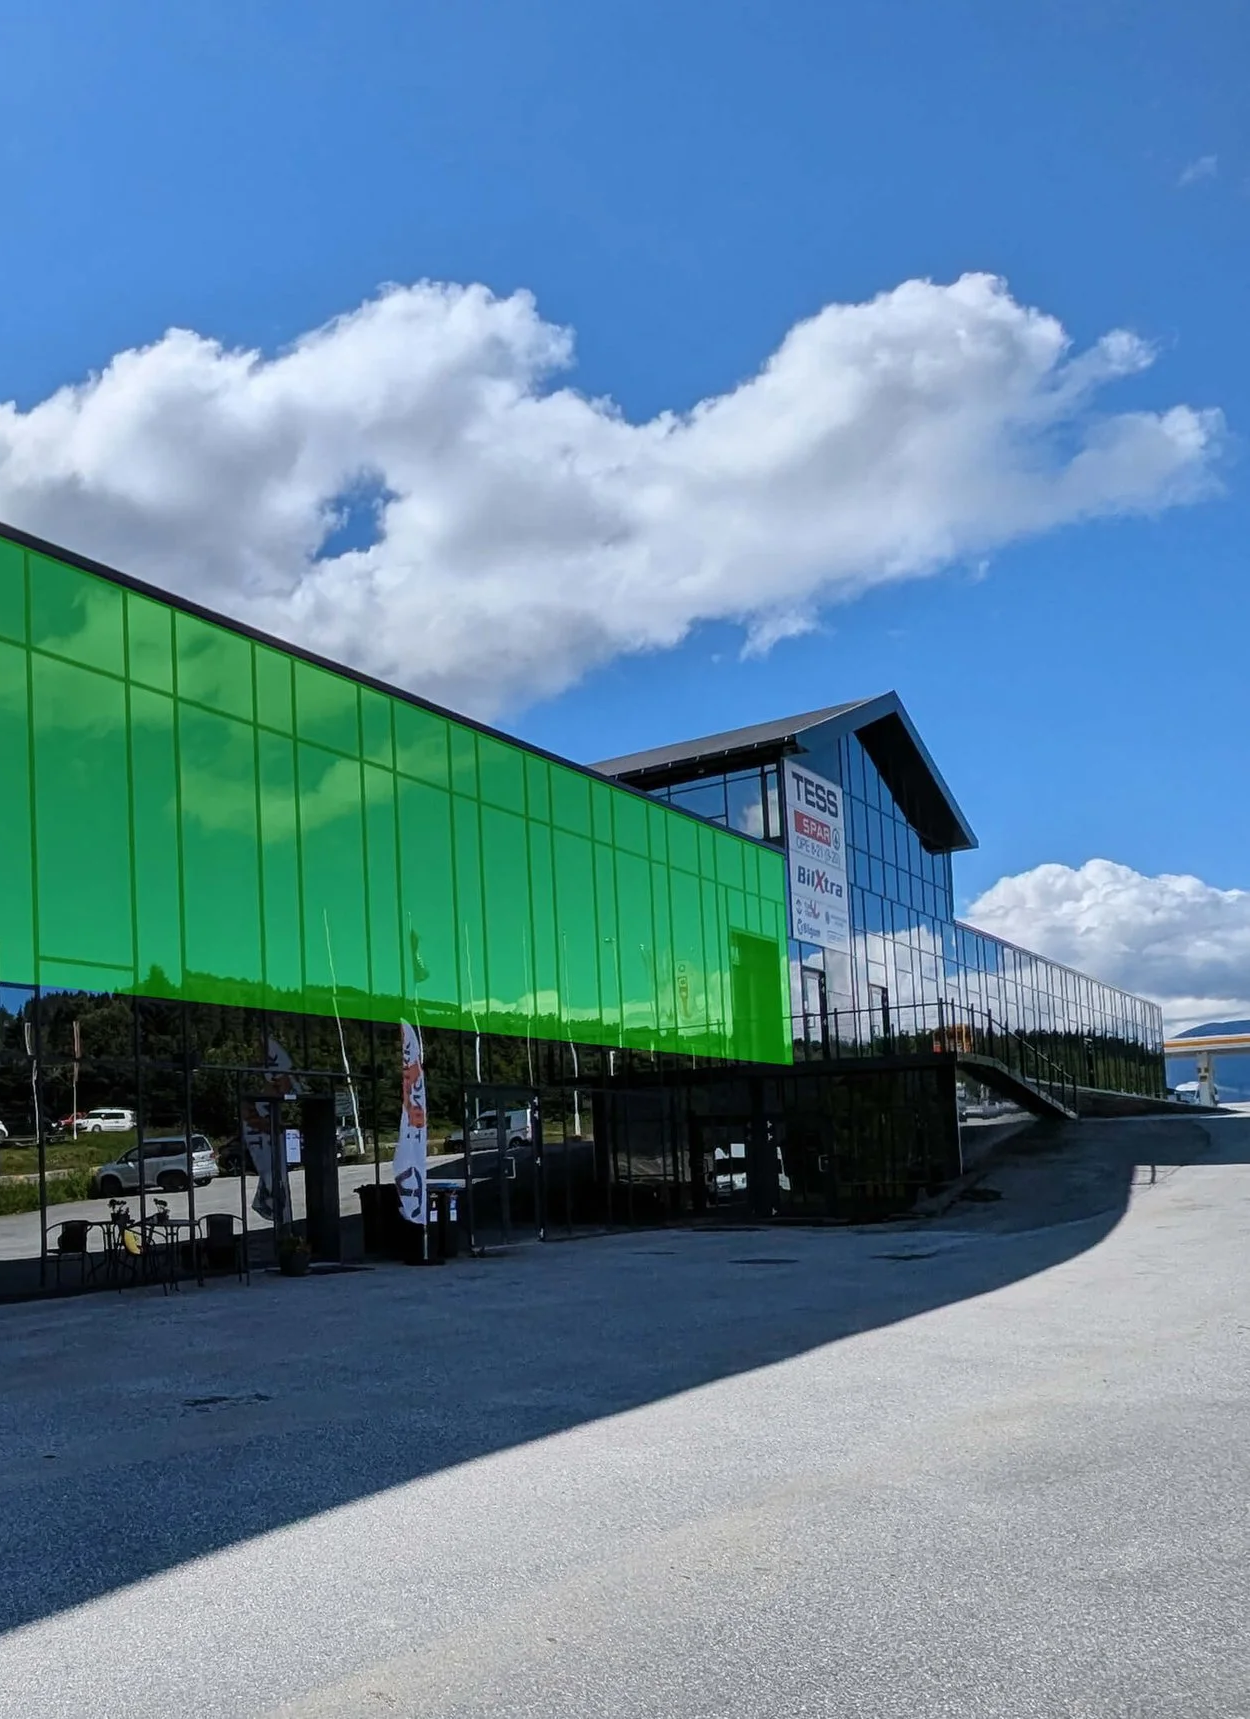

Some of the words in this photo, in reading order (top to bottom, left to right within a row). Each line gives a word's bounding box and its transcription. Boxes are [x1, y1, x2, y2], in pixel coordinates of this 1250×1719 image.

[791, 771, 838, 818] TESS
[802, 818, 830, 843] SPAR
[797, 865, 843, 898] BilXtra
